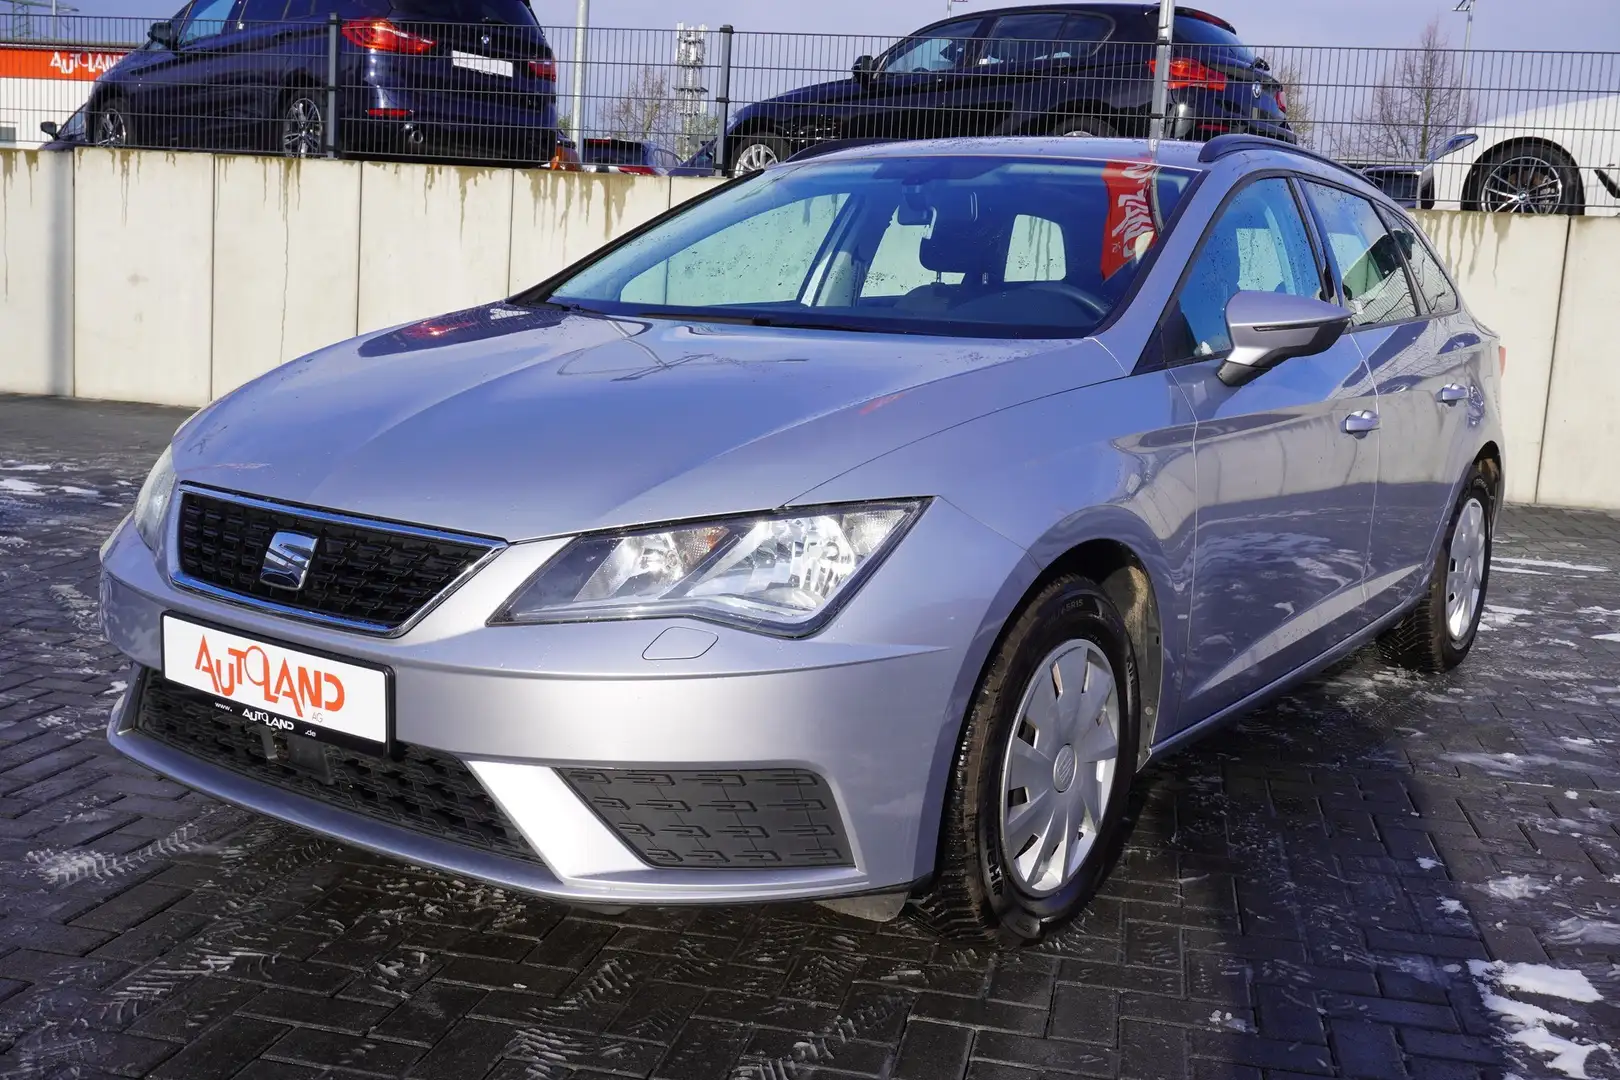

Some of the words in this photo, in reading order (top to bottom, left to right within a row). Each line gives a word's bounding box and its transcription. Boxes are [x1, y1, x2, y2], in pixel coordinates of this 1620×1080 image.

[50, 51, 122, 74] AUTOLAN
[194, 634, 345, 718] AUTOLAND
[242, 708, 295, 730] AUTOLAND
[312, 712, 324, 723] AG
